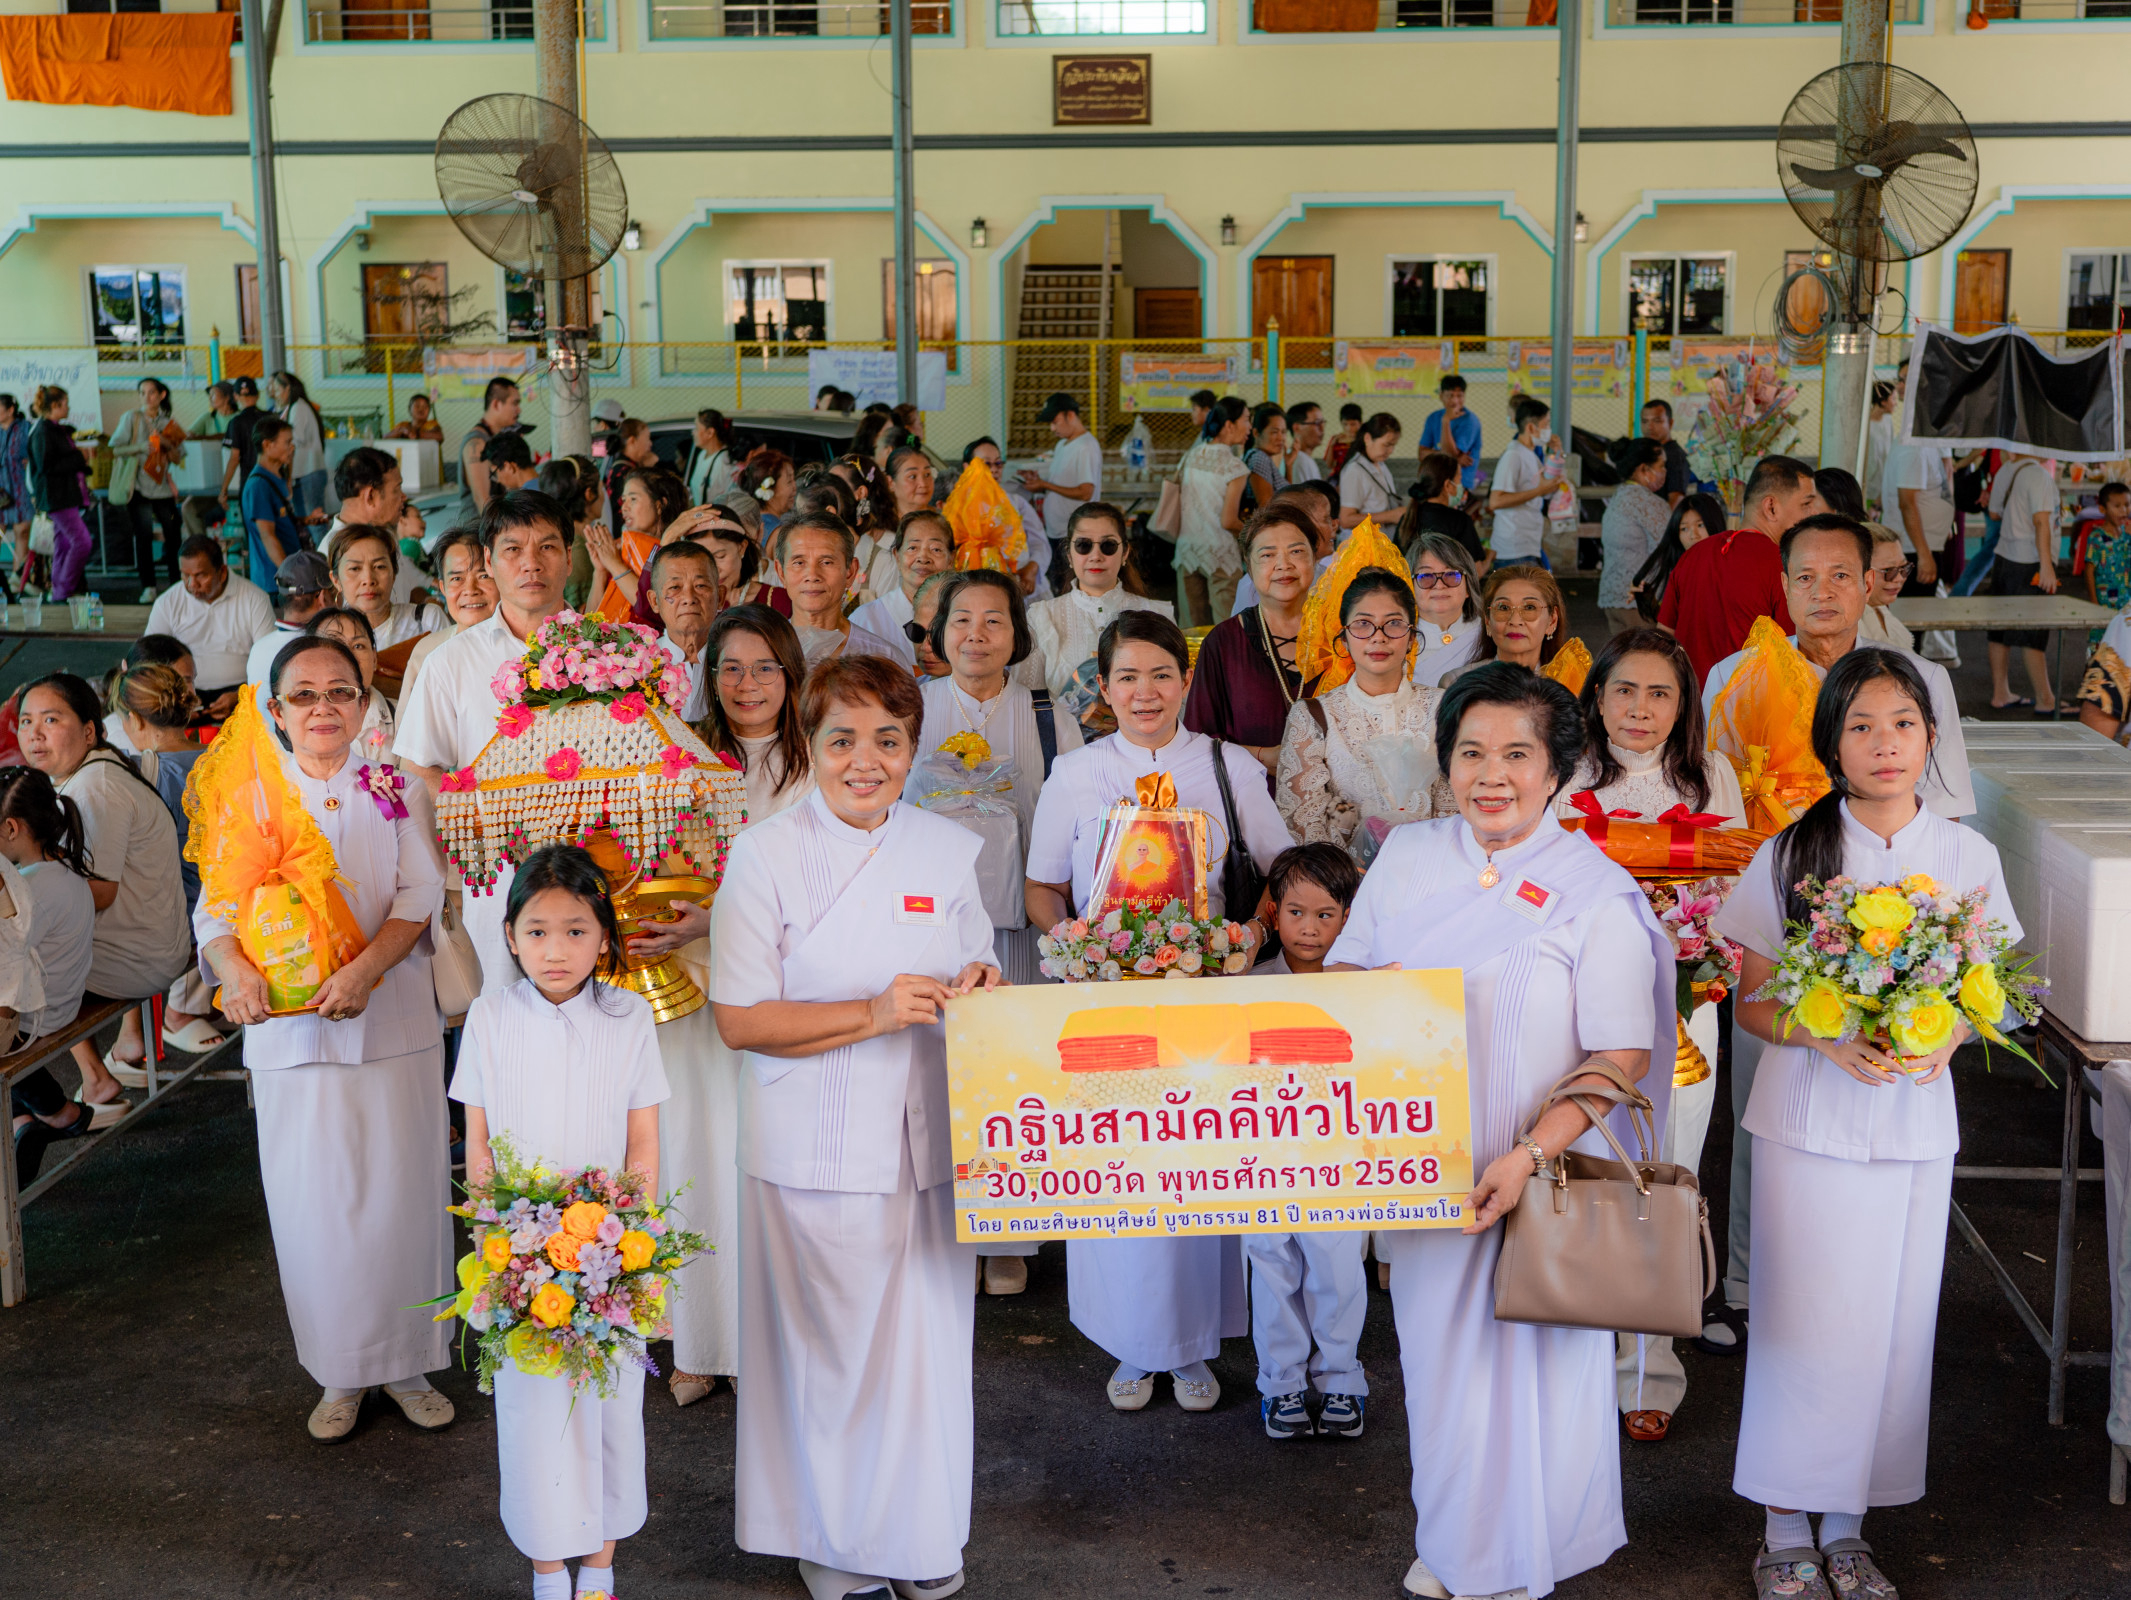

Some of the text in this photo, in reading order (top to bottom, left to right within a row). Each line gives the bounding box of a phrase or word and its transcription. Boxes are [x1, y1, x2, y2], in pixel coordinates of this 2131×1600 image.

[985, 1073, 1433, 1162] กฐินสามัคคีทั่วไทย
[987, 1156, 1440, 1203] 30,000วัด พุทธศักราช 2568
[967, 1198, 1461, 1234] โดย คณะศิษยานุศิษย์ บูชาธรรม 81 ปี หลวงพ่อธัมมชโย
